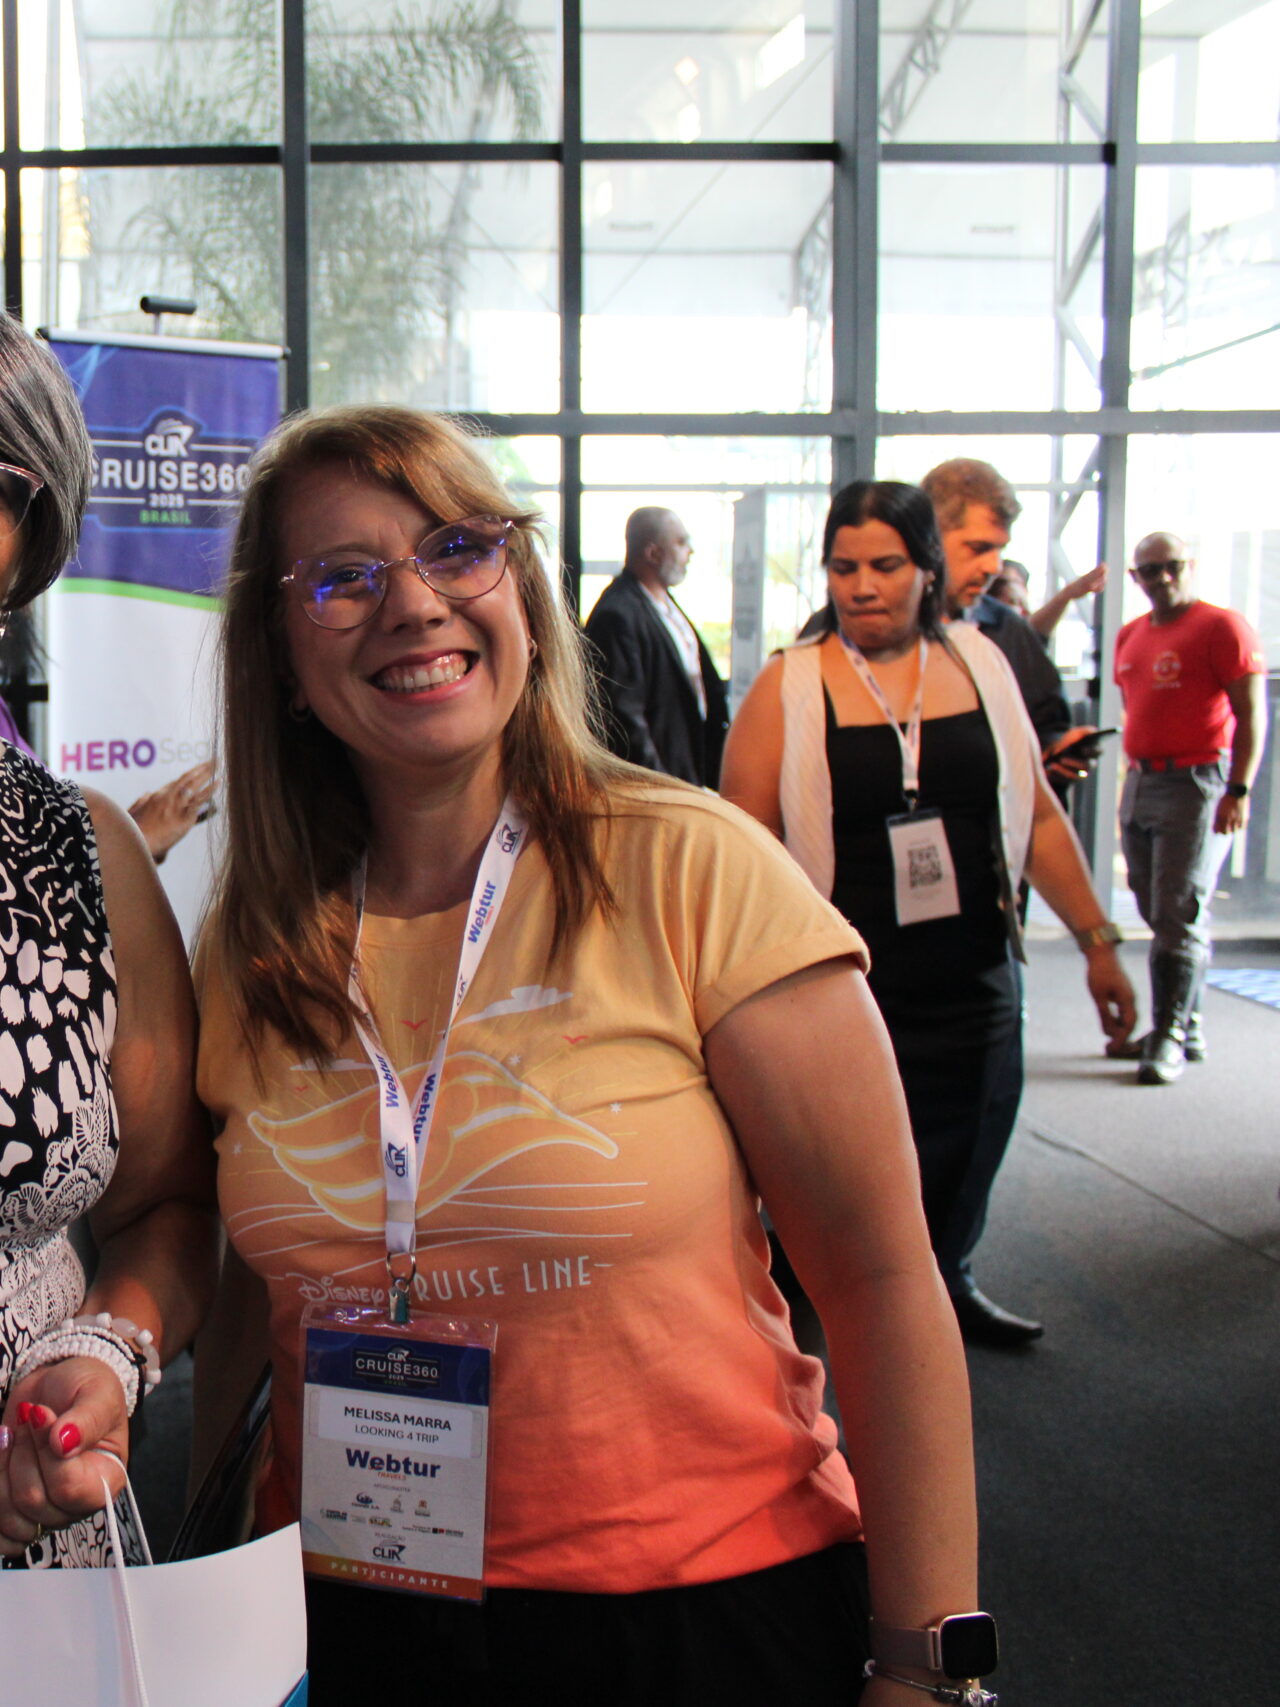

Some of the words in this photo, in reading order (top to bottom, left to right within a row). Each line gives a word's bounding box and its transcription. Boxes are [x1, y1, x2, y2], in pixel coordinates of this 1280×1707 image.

[140, 510, 192, 524] BRASIL
[61, 739, 157, 772] HERO
[468, 881, 496, 944] Webtur
[375, 1054, 400, 1108] Webtur
[413, 1266, 505, 1302] RUISE
[523, 1256, 592, 1293] LINE
[355, 1358, 438, 1378] CRUISE360
[344, 1406, 400, 1424] MELISSA
[404, 1414, 452, 1431] MARRA
[354, 1424, 404, 1440] LOOKING
[416, 1433, 440, 1443] TRIP
[345, 1447, 442, 1478] Webtur
[331, 1561, 449, 1589] PARTICIPANTE
